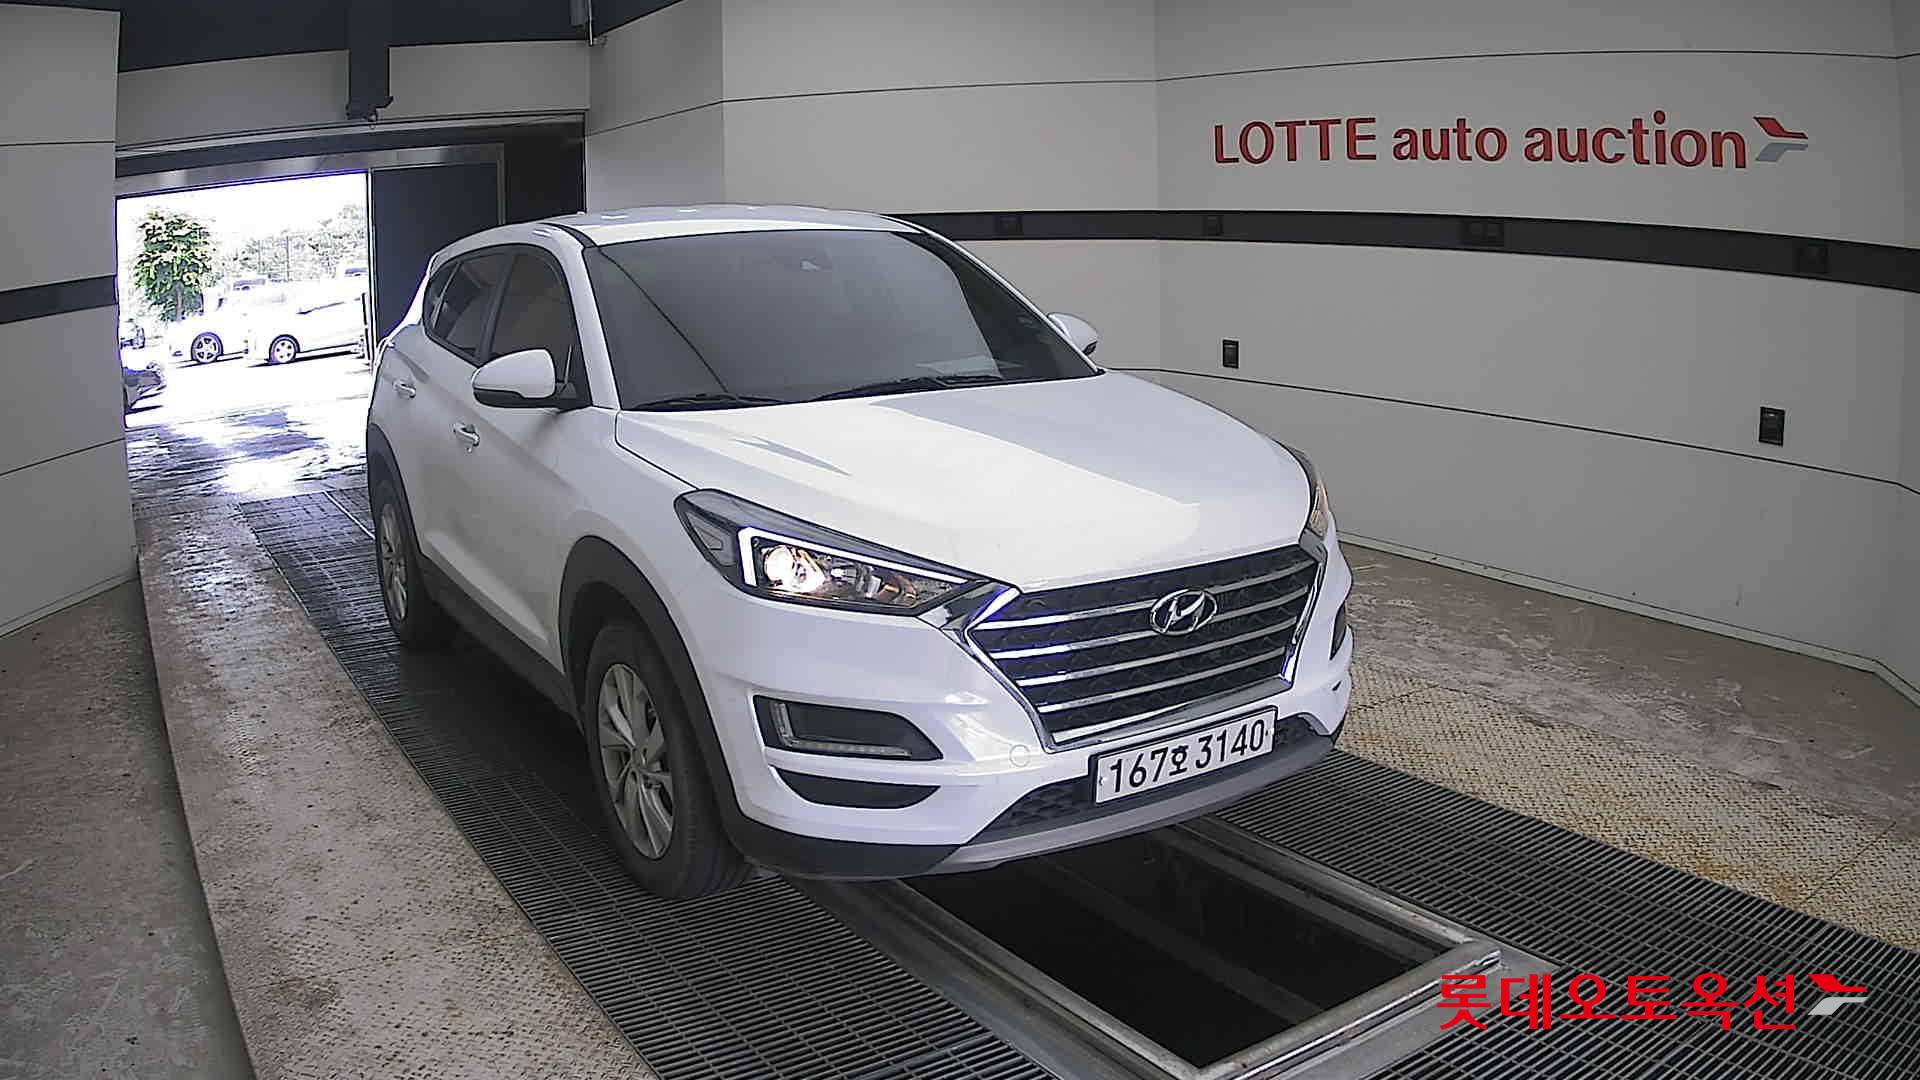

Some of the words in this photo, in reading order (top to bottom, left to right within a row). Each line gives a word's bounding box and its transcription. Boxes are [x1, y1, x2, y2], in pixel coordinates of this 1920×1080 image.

[1214, 117, 1376, 164] LOTTE
[1393, 118, 1508, 162] auto
[1524, 110, 1747, 168] auction
[1110, 744, 1189, 793] 167호
[1196, 719, 1265, 769] 3140
